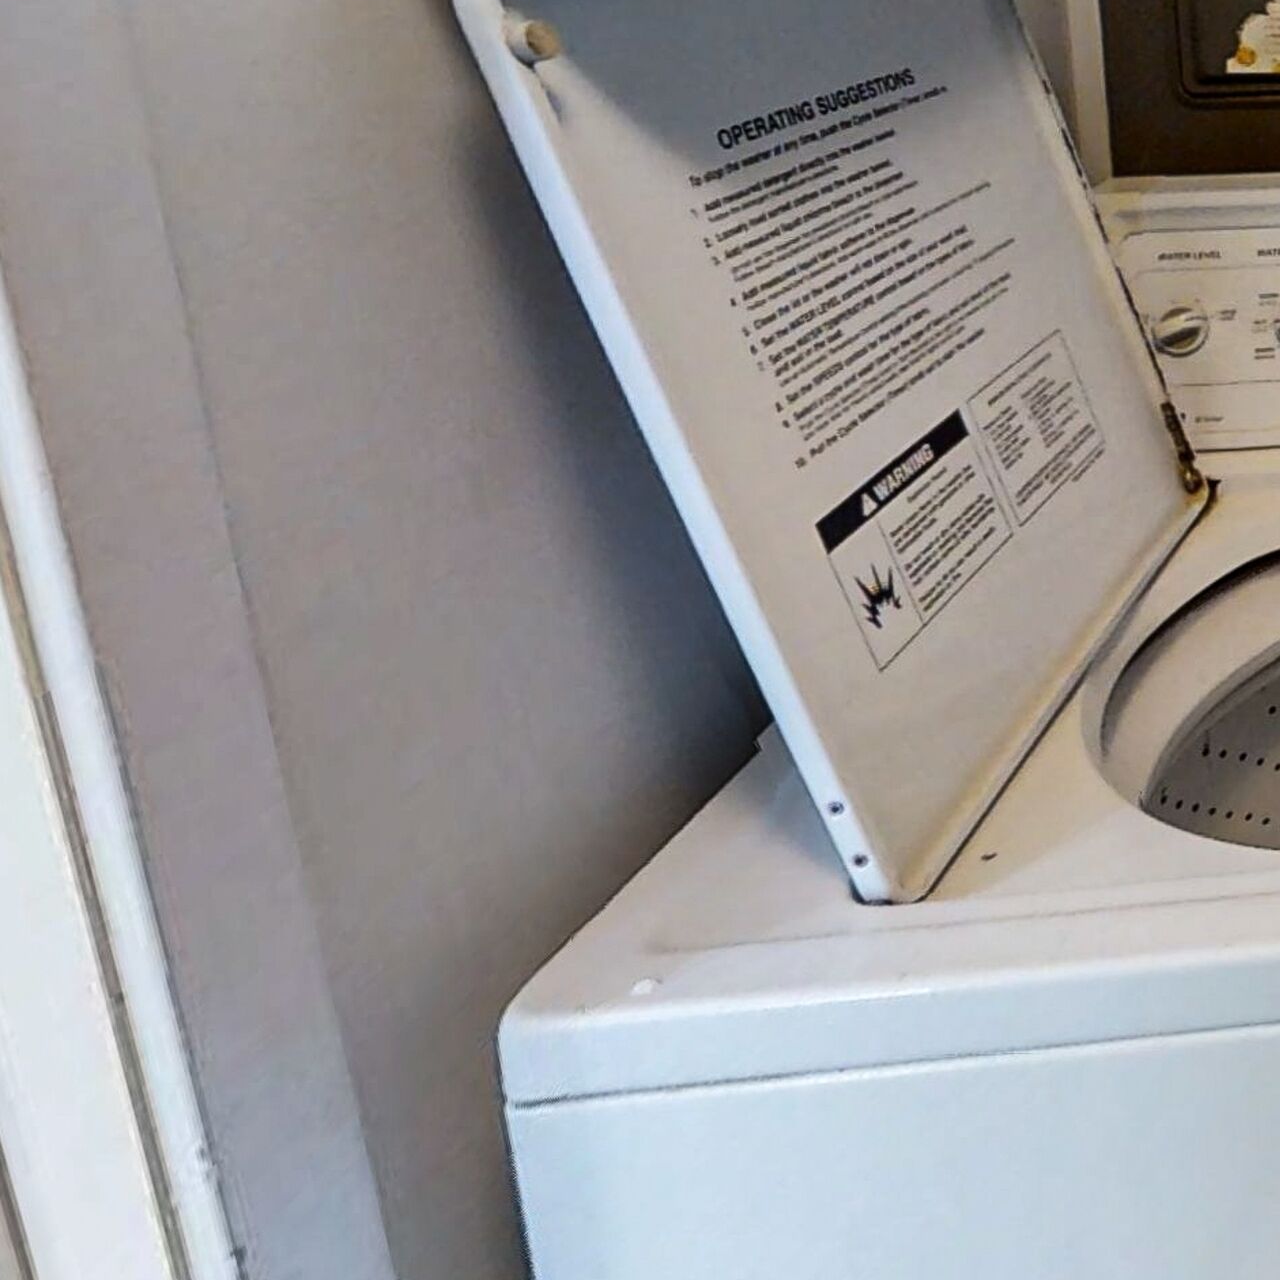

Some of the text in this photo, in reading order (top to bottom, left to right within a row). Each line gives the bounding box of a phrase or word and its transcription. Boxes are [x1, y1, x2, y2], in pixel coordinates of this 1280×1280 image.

[717, 100, 815, 150] OPERATING
[816, 68, 915, 116] SUGGESTIONS
[872, 442, 935, 503] WARNING
